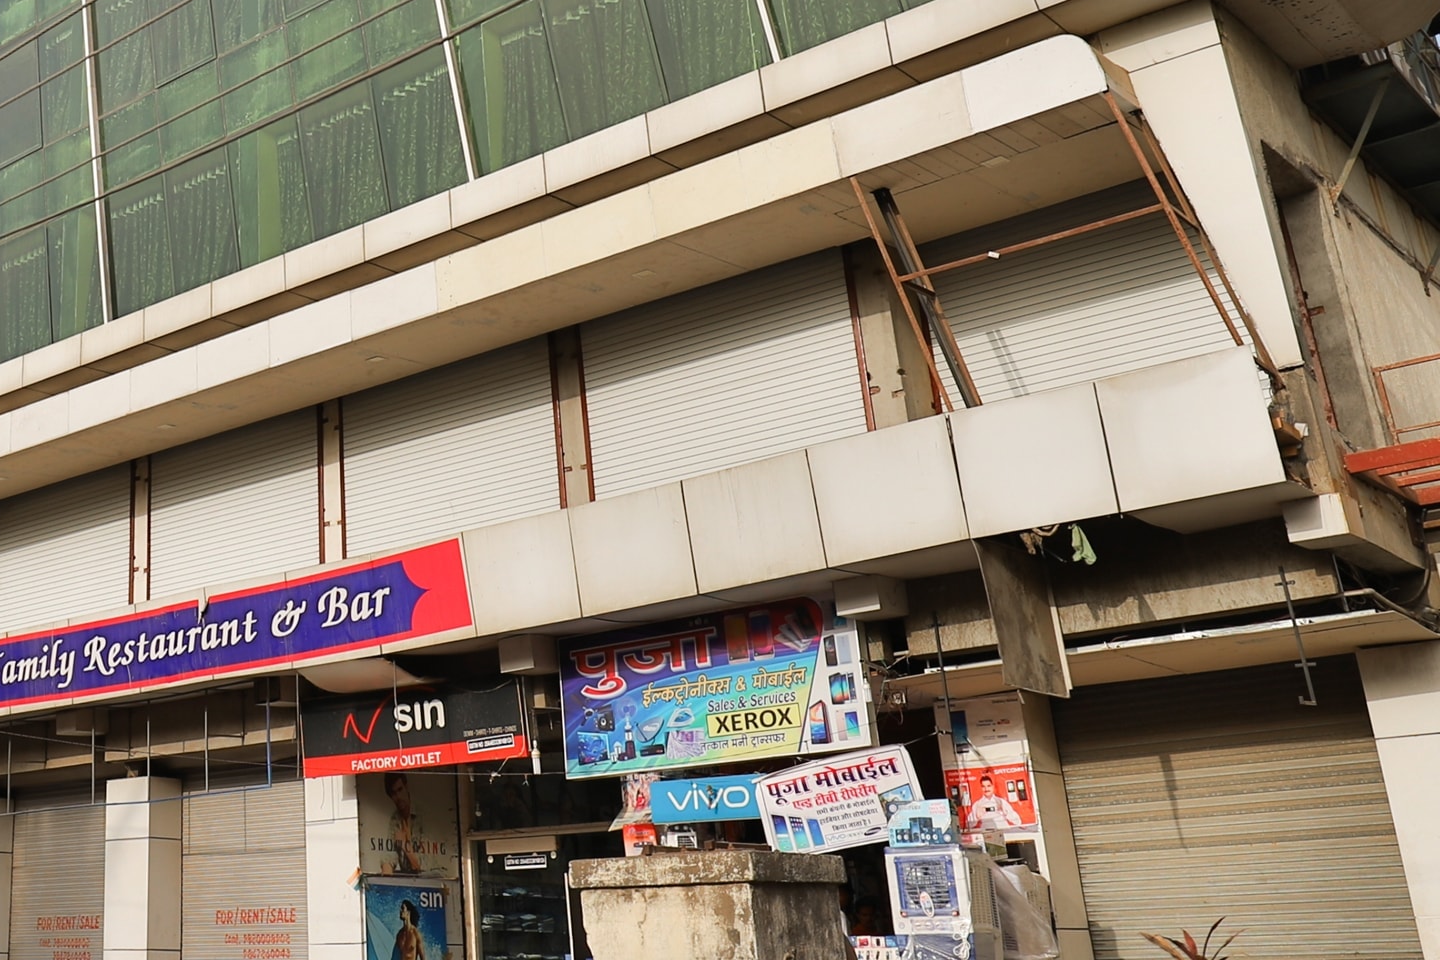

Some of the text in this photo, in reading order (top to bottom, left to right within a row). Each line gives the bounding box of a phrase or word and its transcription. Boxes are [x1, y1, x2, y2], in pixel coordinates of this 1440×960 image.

[83, 609, 258, 676] Restaurant
[270, 598, 307, 638] &
[317, 586, 391, 628] Bar
[735, 675, 747, 692] &
[707, 691, 796, 713] Sales & Services
[393, 697, 447, 733] sin
[716, 707, 793, 734] XEROX
[351, 751, 442, 772] FACTORY OUTLET
[420, 891, 443, 908] sin
